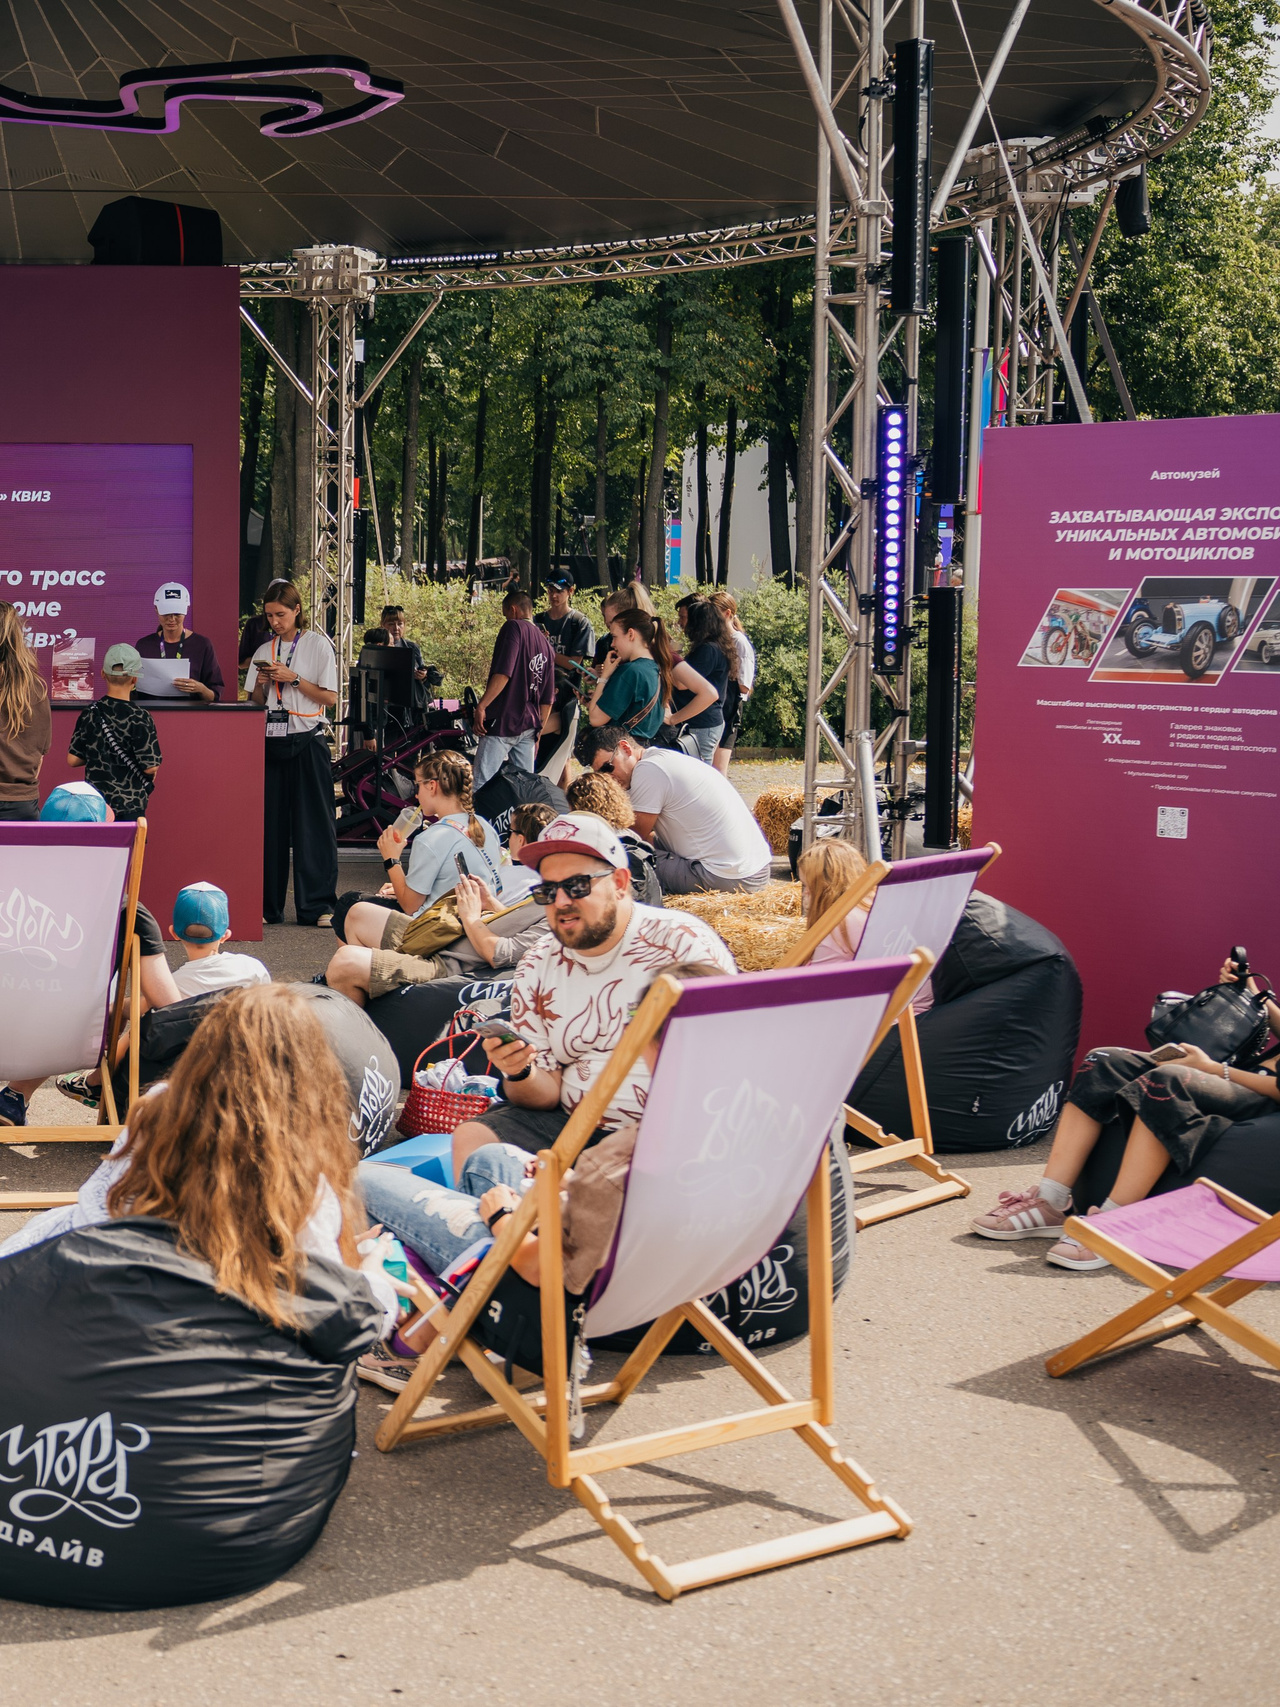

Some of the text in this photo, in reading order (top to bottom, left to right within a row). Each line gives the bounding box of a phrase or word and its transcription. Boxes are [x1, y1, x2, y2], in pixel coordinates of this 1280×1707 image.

[1150, 468, 1221, 481] Автомузей
[11, 490, 51, 502] КВИЗ
[1048, 506, 1280, 524] ЗАХВАТЫВАЮЩАЯ ЭКСПО
[1055, 528, 1177, 542] УНИКАЛЬНЫХ
[1108, 547, 1255, 562] И МОТОЦИКЛОВ
[30, 570, 106, 590] трасс
[1036, 699, 1084, 708] Масштабное
[1085, 701, 1136, 709] выставочное
[1137, 703, 1192, 712] пространство
[1232, 708, 1278, 716] автодрома
[1170, 723, 1242, 733] Галерея знаковых
[1102, 732, 1122, 744] XX
[1200, 743, 1229, 751] легенд
[1230, 744, 1277, 754] автоспорта
